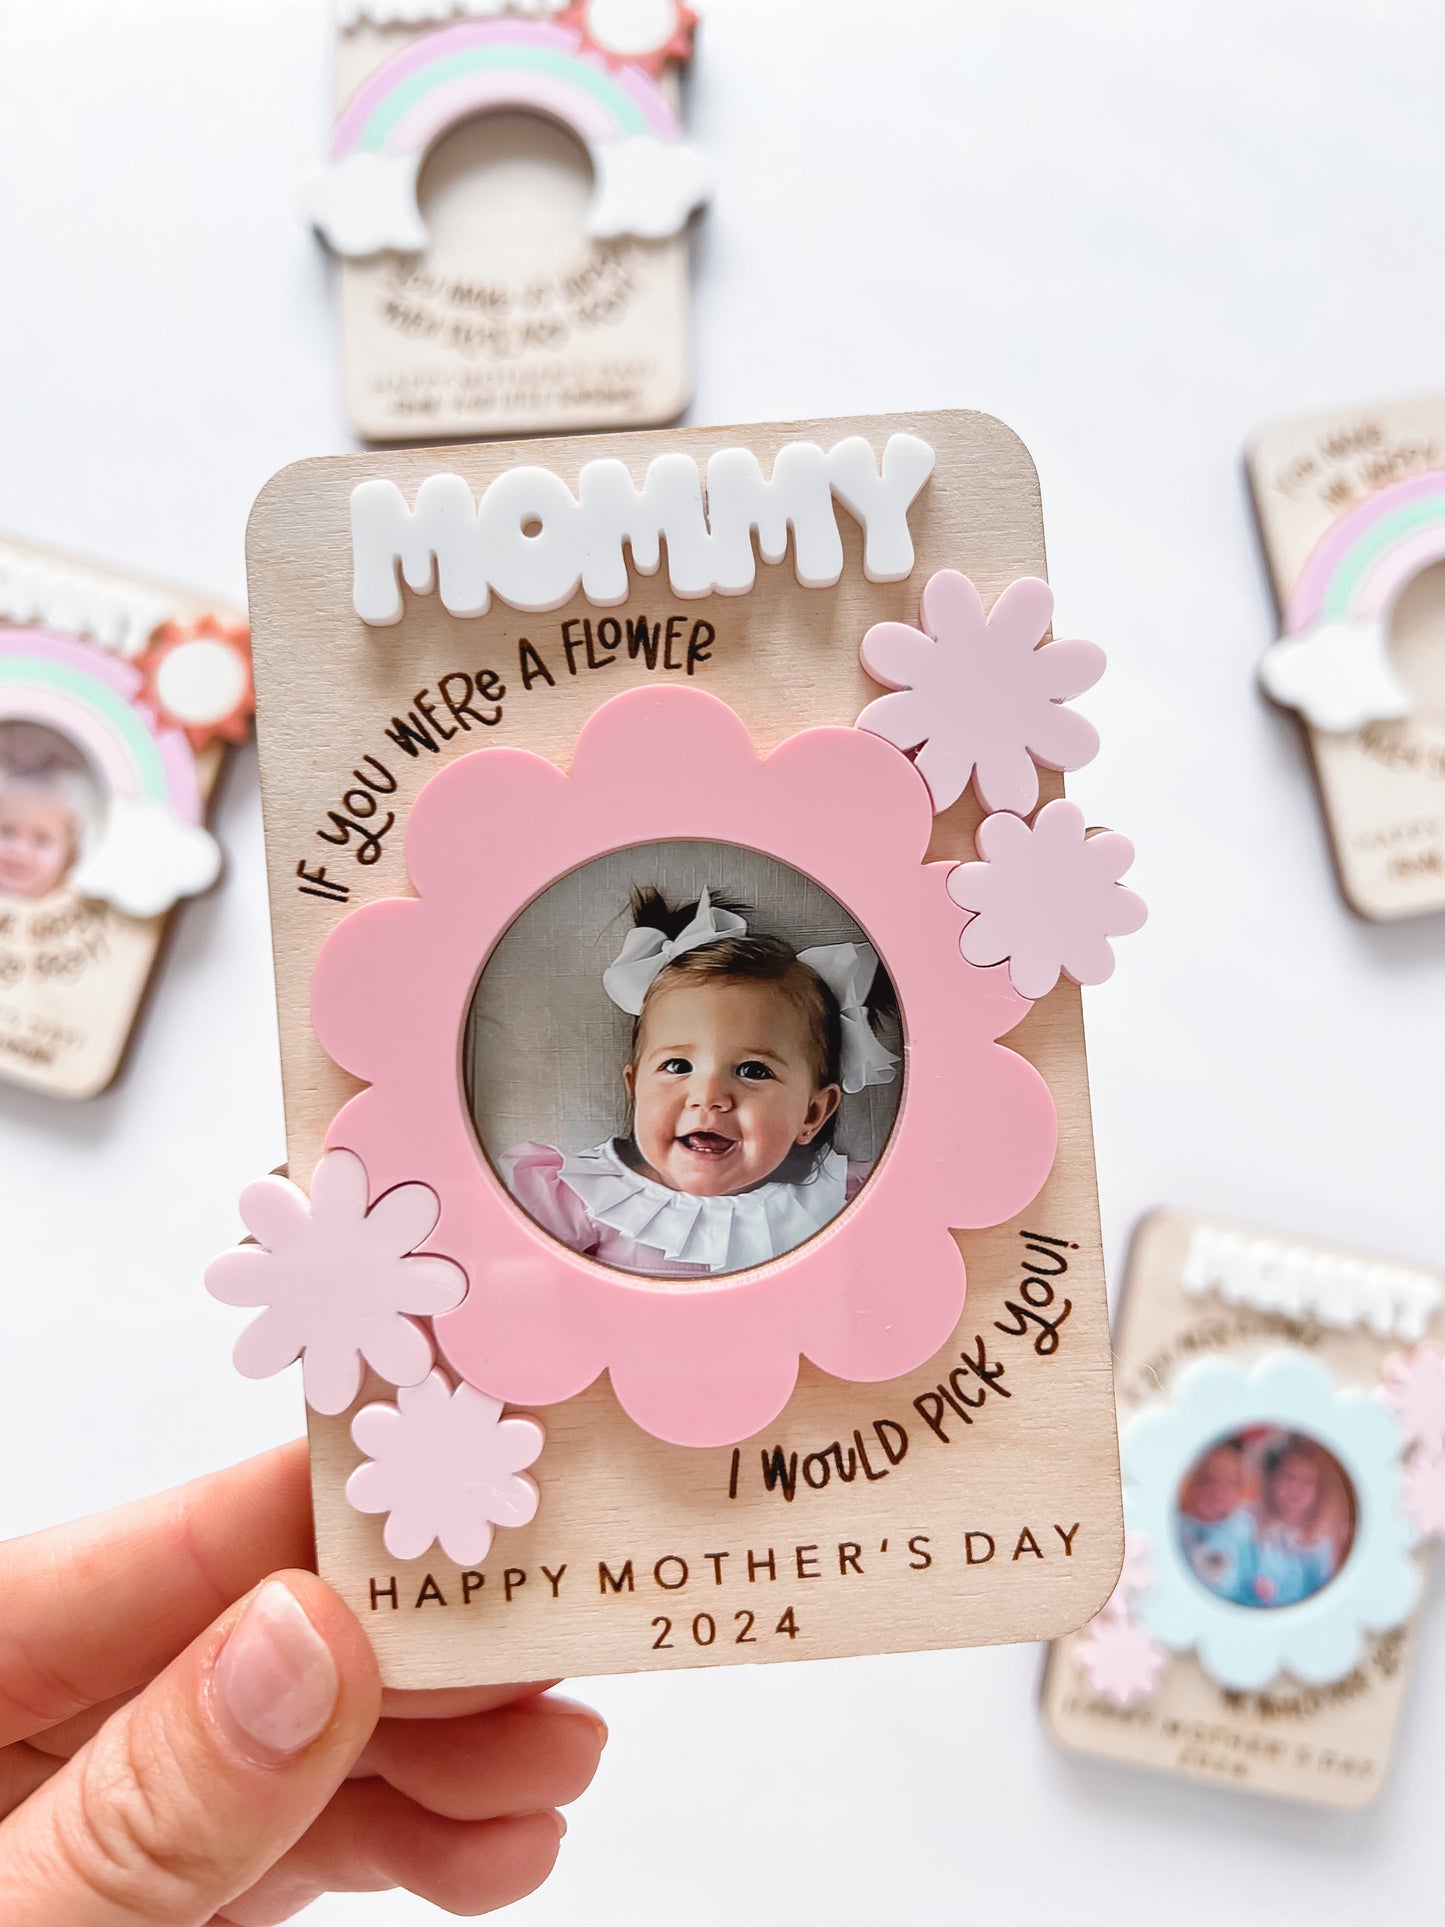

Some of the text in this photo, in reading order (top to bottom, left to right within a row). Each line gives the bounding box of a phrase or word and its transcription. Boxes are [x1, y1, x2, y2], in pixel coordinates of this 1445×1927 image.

[350, 433, 936, 627] MOMMY
[517, 637, 556, 692] A
[317, 753, 398, 867] YOU
[297, 858, 351, 903] IF
[728, 1447, 741, 1500] I
[761, 1418, 909, 1503] WOULD
[912, 1335, 1012, 1445] PICK
[994, 1229, 1081, 1356] YOU!
[369, 1521, 1081, 1612] HAPPY MOTHER'S DAY
[651, 1606, 801, 1650] 2024
